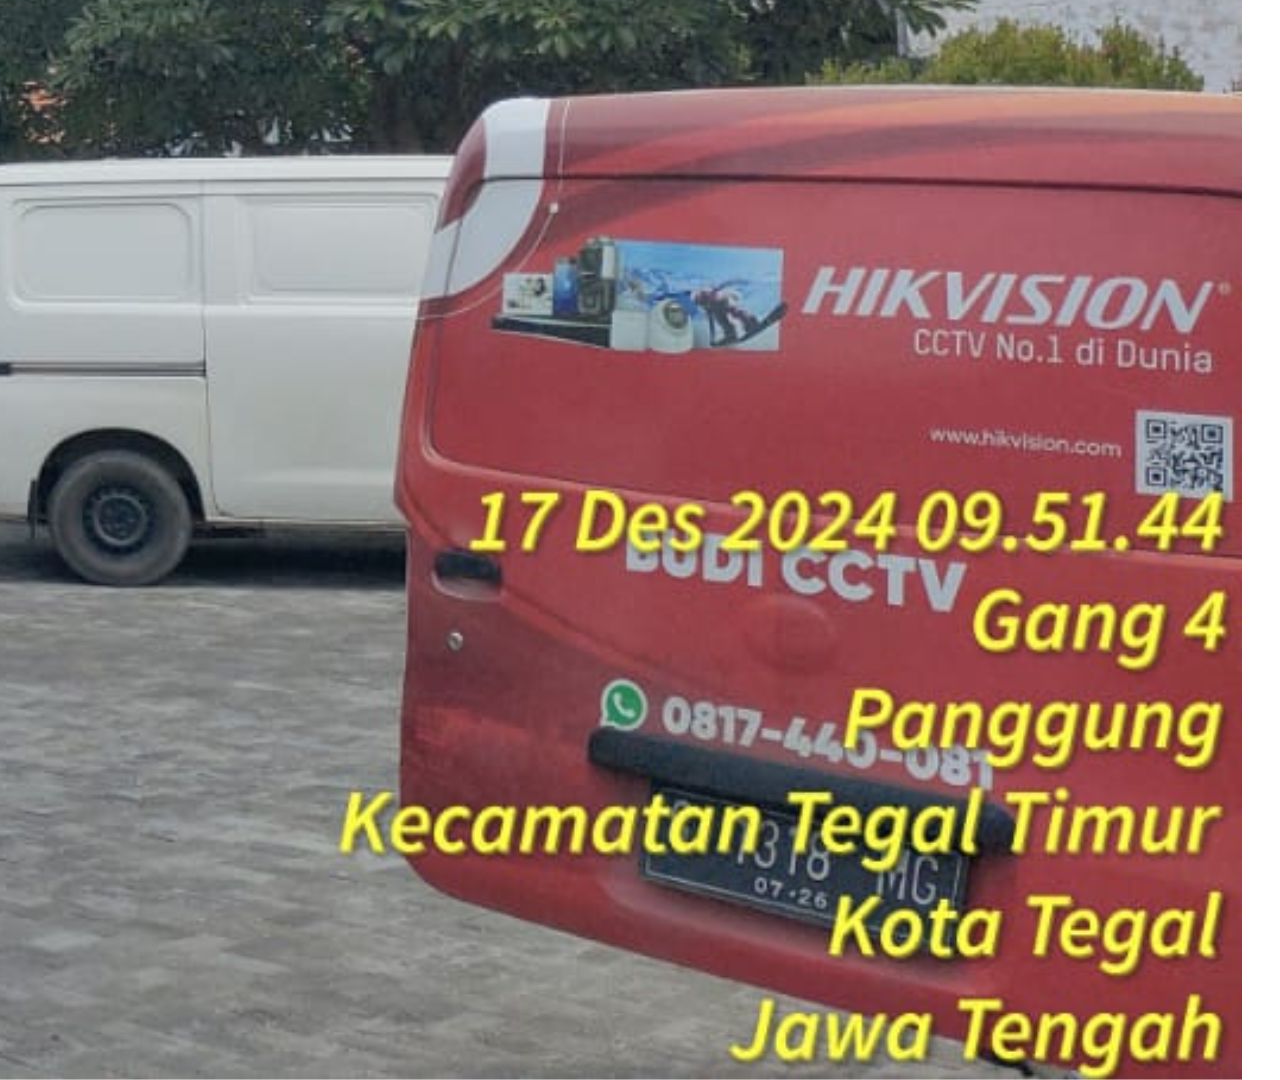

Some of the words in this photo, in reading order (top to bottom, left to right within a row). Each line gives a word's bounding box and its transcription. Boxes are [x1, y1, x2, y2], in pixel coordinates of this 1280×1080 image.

[801, 265, 1215, 334] HIKVISION
[912, 327, 987, 358] CCTV
[996, 333, 1064, 365] No.1
[1075, 338, 1105, 367] di
[1116, 340, 1215, 375] Dunia
[929, 426, 1123, 459] www.hikvision.com
[626, 528, 763, 587] BUDI
[781, 542, 967, 613] CCTV
[662, 696, 993, 791] 0817-440-081
